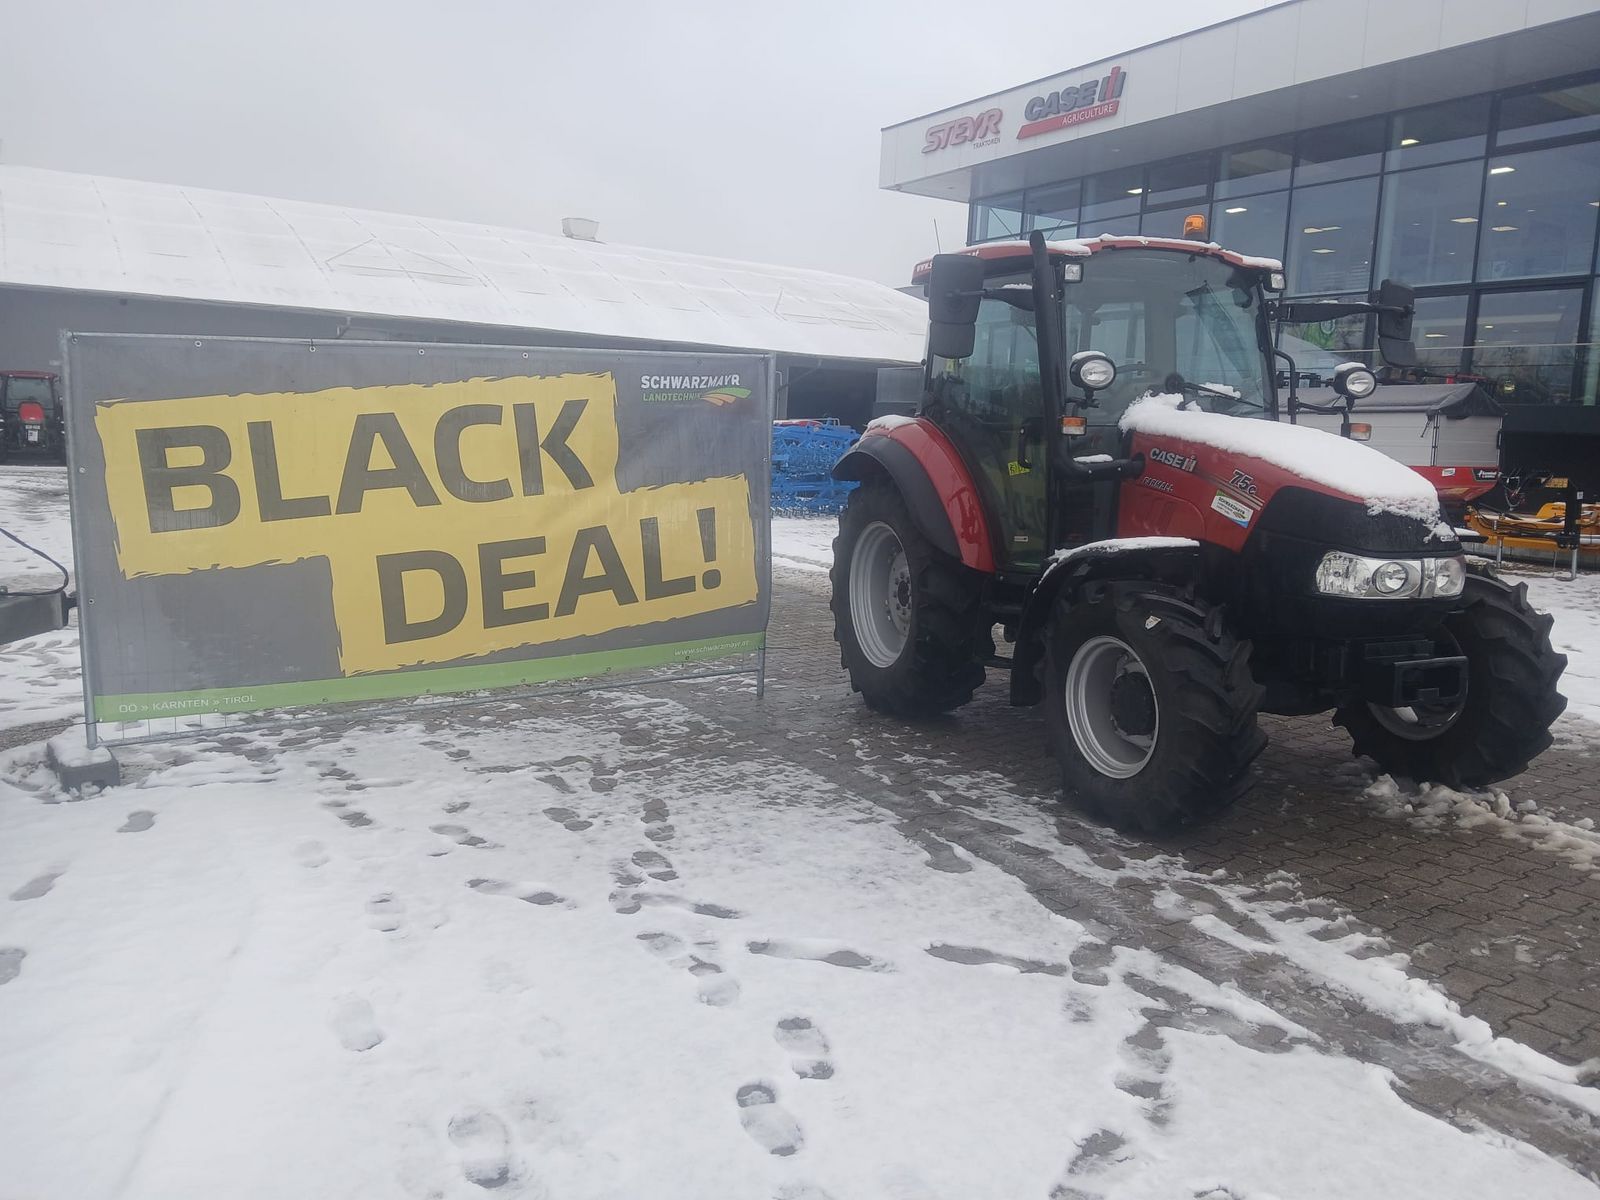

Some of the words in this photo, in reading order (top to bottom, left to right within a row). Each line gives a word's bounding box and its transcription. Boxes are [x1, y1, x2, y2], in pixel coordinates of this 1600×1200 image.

[1024, 79, 1098, 121] CASE
[1061, 104, 1114, 126] AGRICULTURE
[921, 107, 1003, 153] STEYR
[973, 137, 1001, 150] TRAKTOREN
[641, 374, 740, 389] SCHWARZMAYR
[135, 398, 595, 534] BLACK
[1150, 447, 1185, 470] CASE
[376, 506, 722, 645] DEAL!
[223, 694, 257, 705] TIROL
